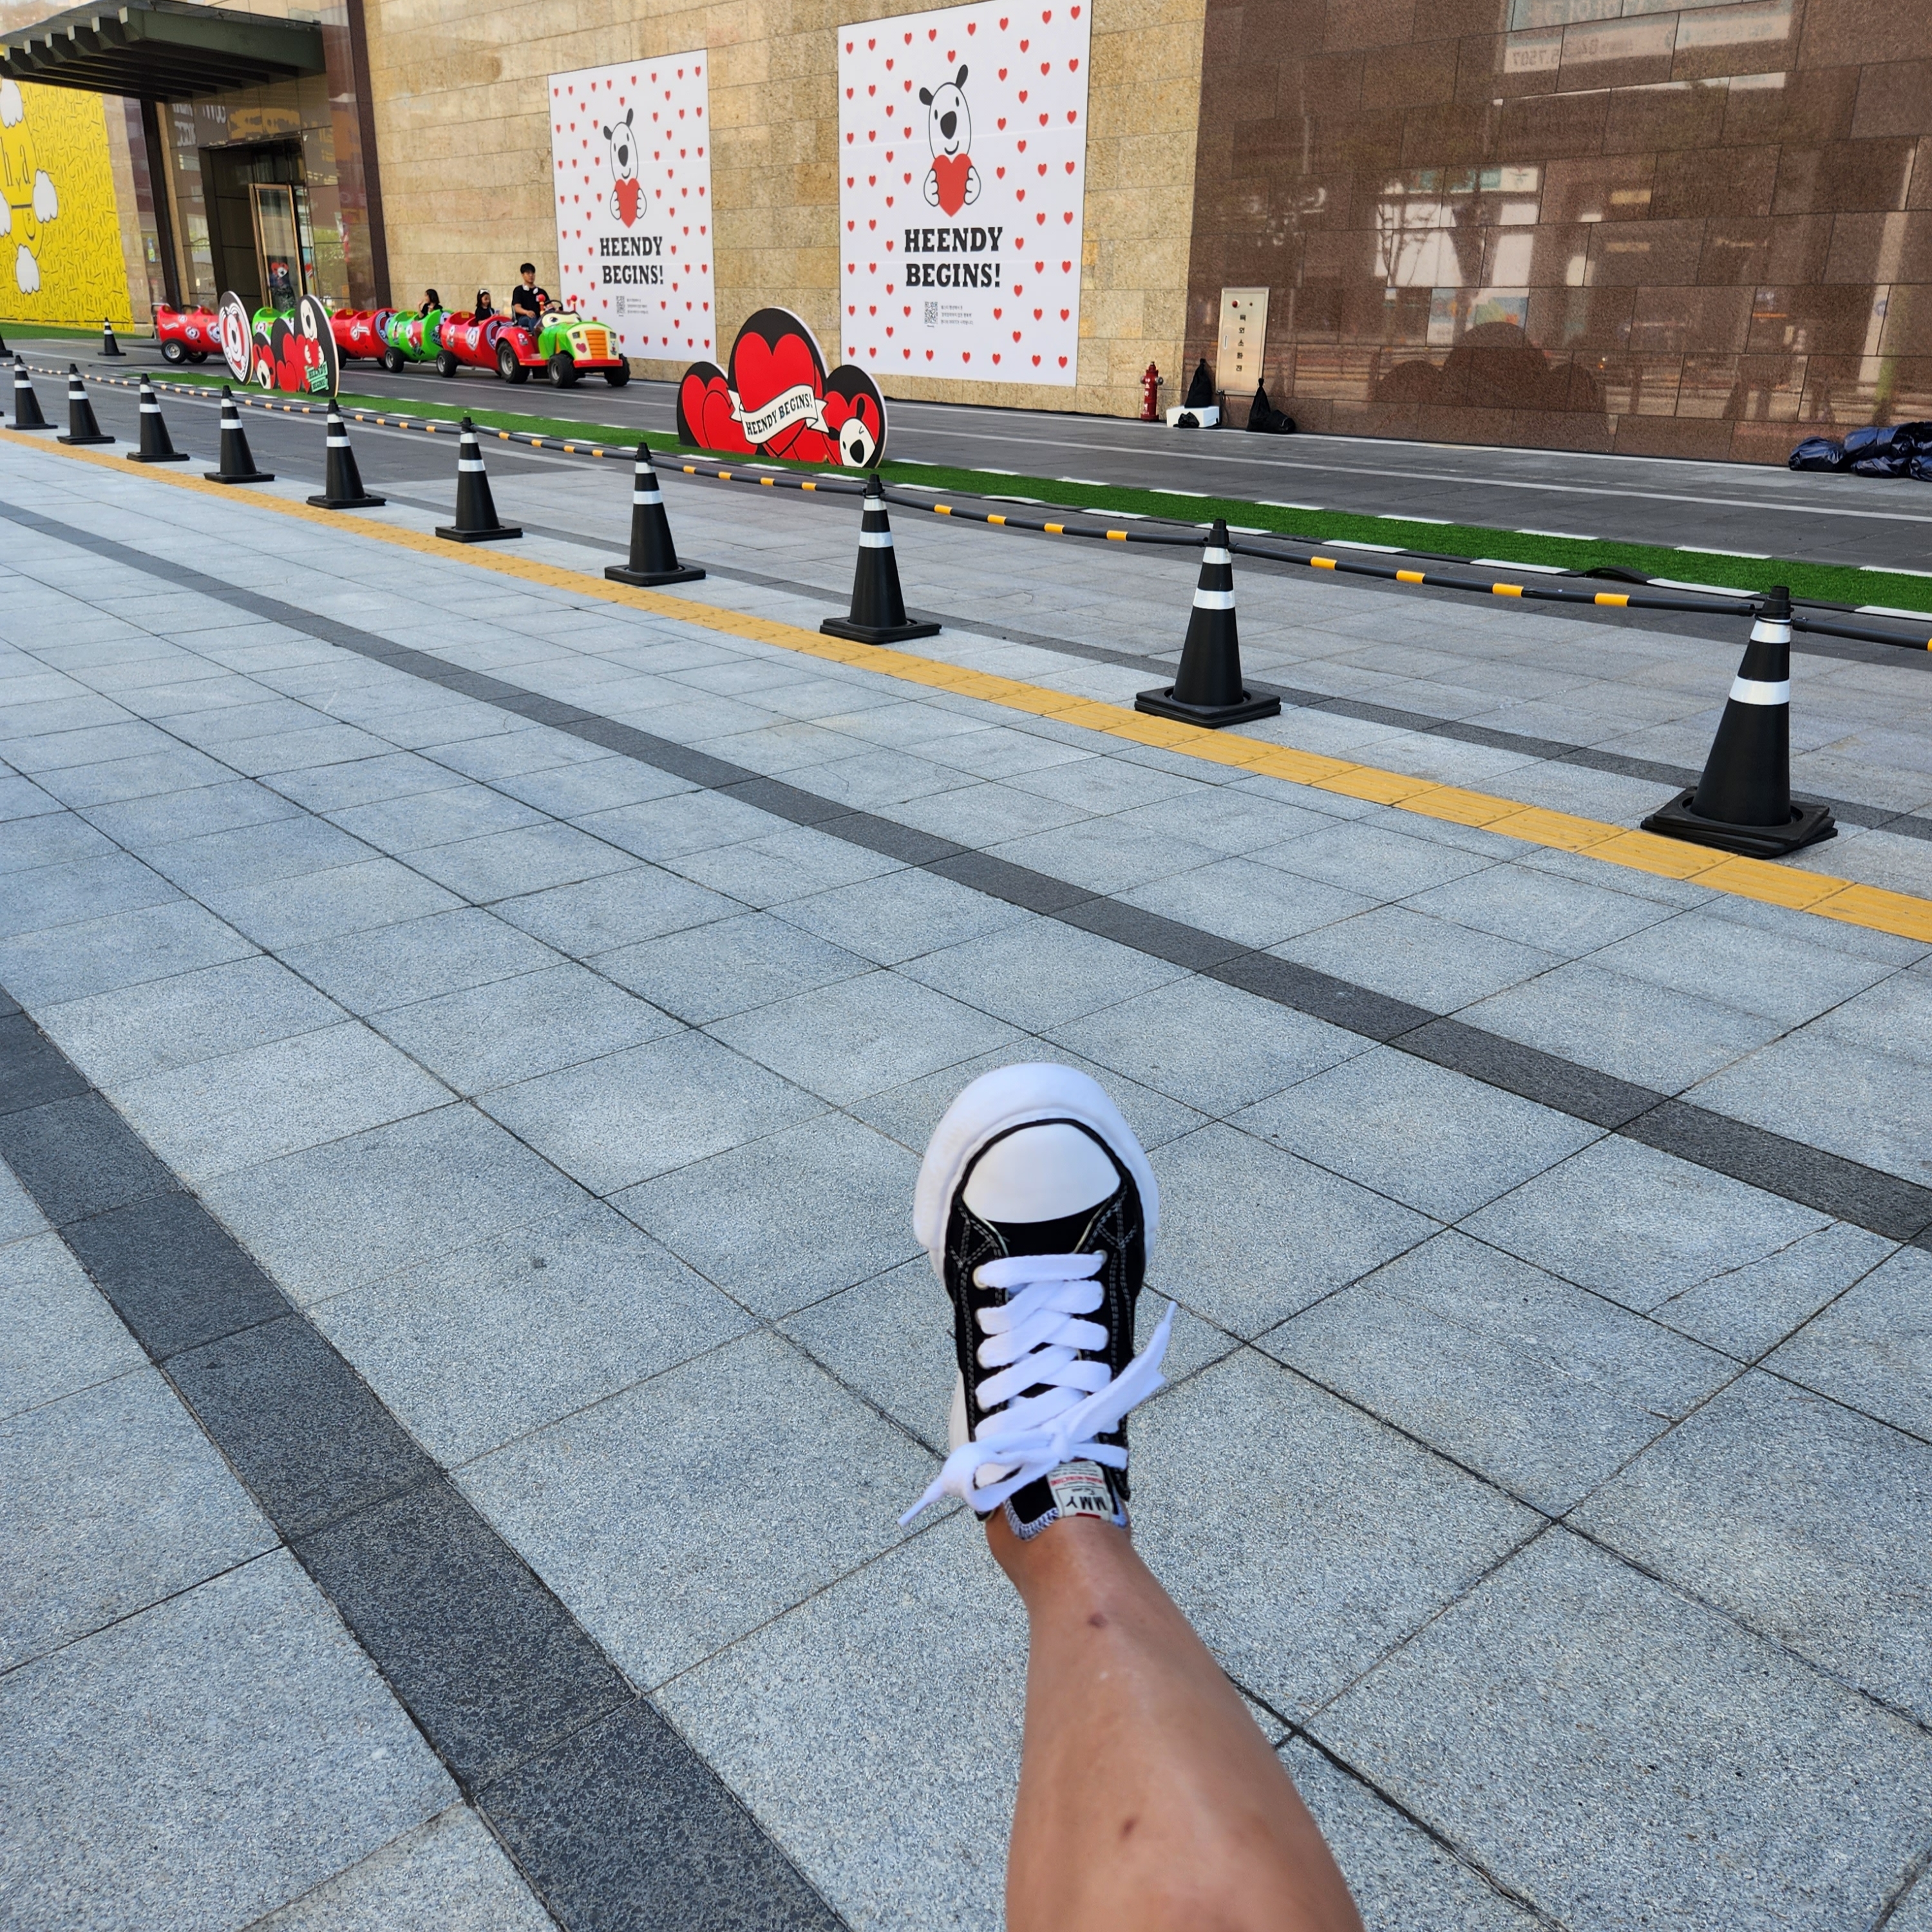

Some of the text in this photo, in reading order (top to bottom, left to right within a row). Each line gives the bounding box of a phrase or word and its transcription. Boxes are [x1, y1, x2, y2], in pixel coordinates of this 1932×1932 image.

[600, 236, 663, 256] HEENDY
[905, 227, 1003, 252] HEENDY
[602, 265, 664, 285] BEGINS!
[906, 263, 1000, 288] BEGINS!
[745, 393, 813, 436] HEENDY BEGINS!
